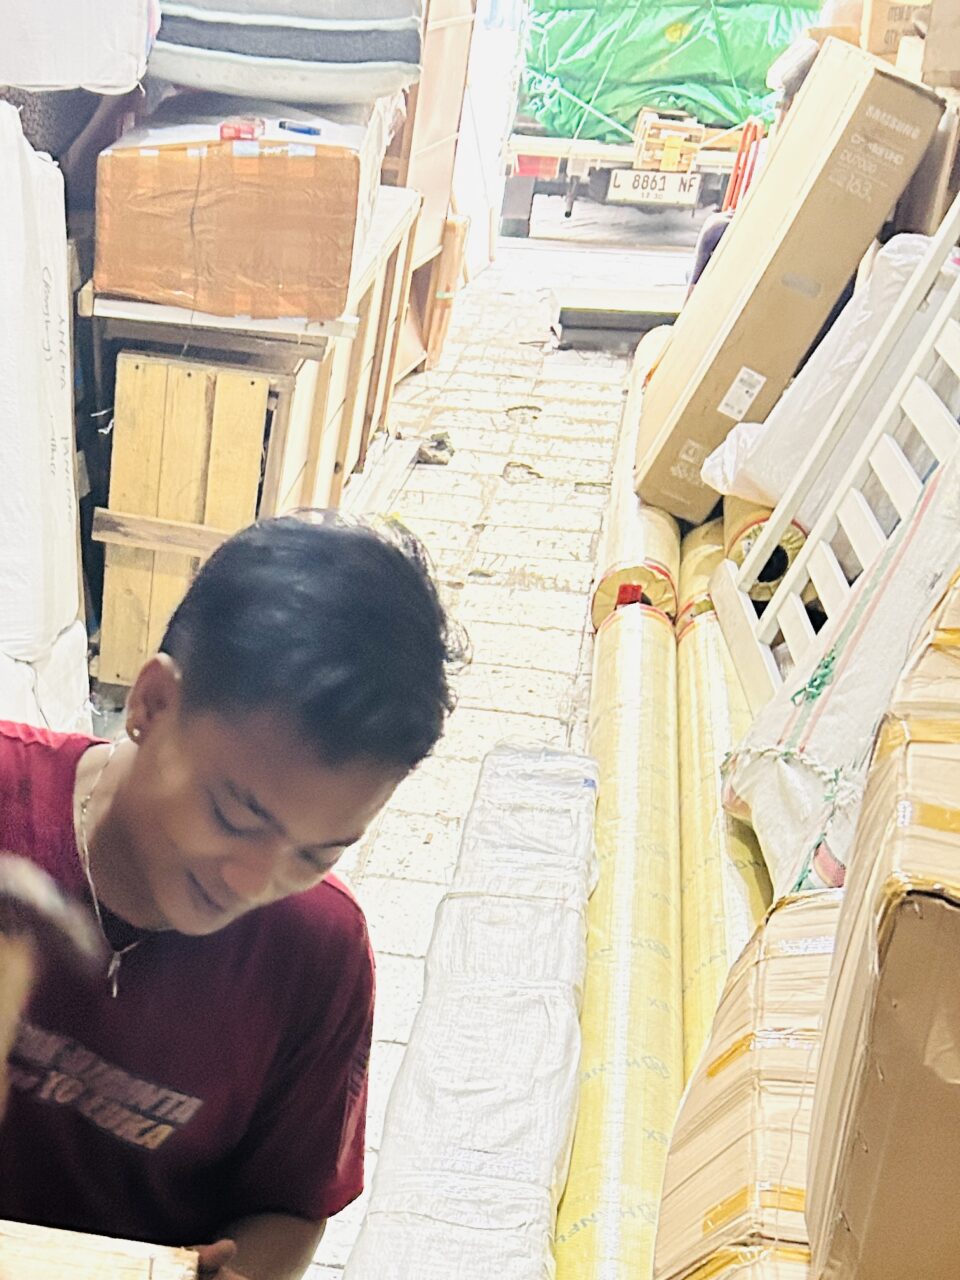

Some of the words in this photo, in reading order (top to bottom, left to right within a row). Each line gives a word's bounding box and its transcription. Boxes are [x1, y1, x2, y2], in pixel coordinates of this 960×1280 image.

[612, 172, 622, 189] L
[631, 174, 667, 192] 8861
[677, 176, 697, 193] NF
